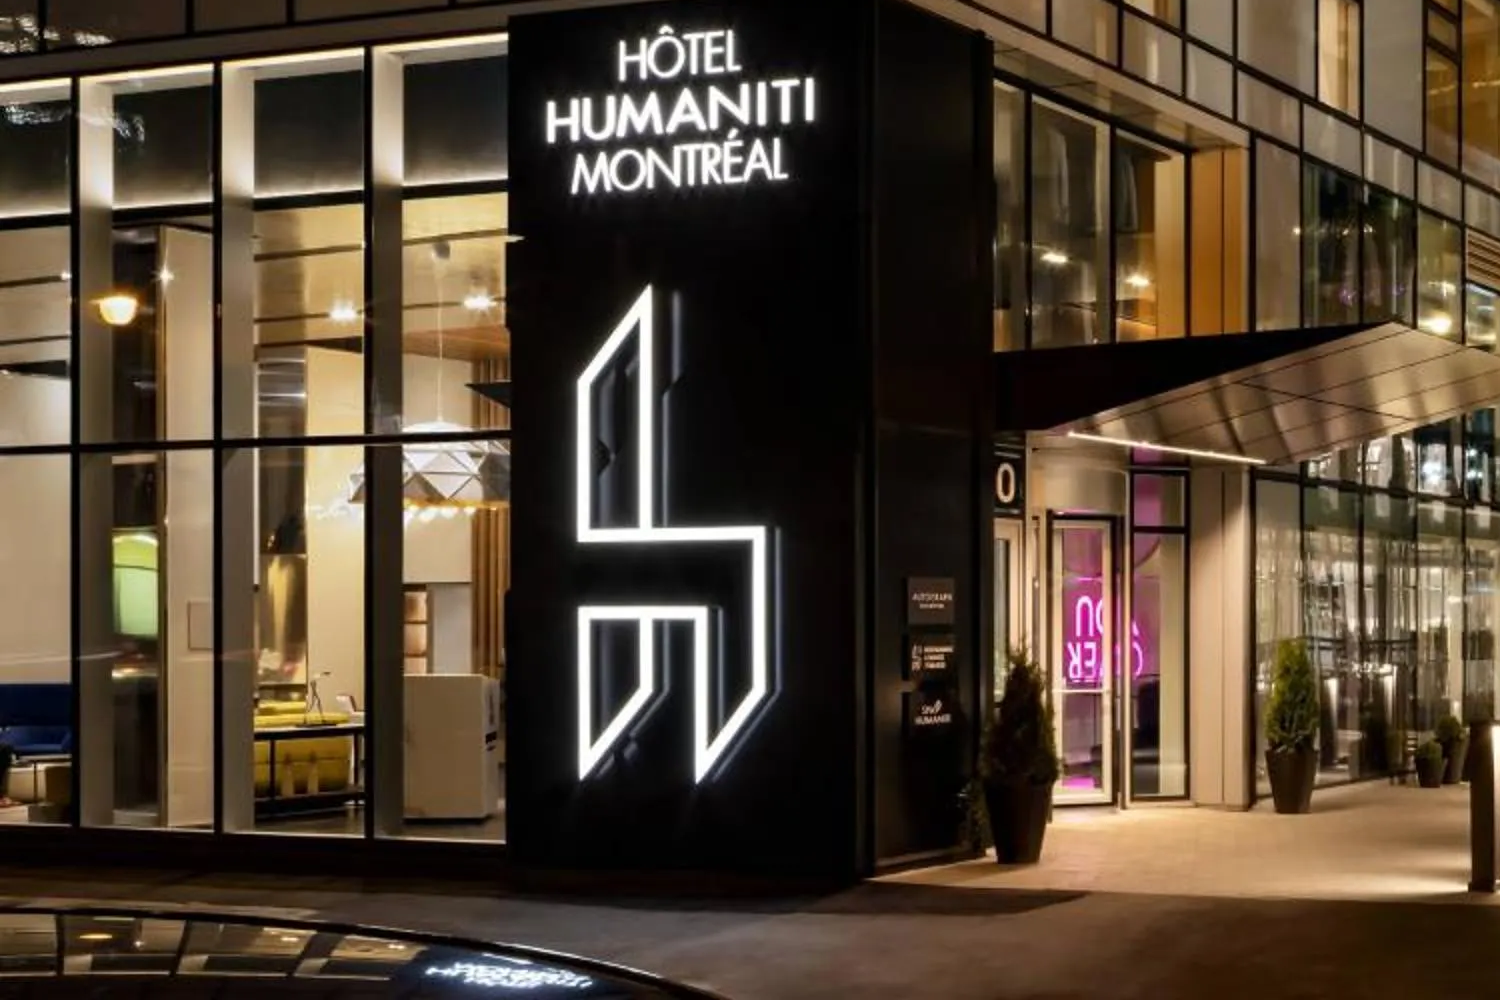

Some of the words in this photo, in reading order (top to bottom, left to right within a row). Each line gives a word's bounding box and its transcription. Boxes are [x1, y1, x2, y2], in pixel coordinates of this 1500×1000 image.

[617, 24, 743, 83] HÔTEL
[546, 76, 815, 144] HUMANITI
[571, 128, 789, 195] MONTRÉAL
